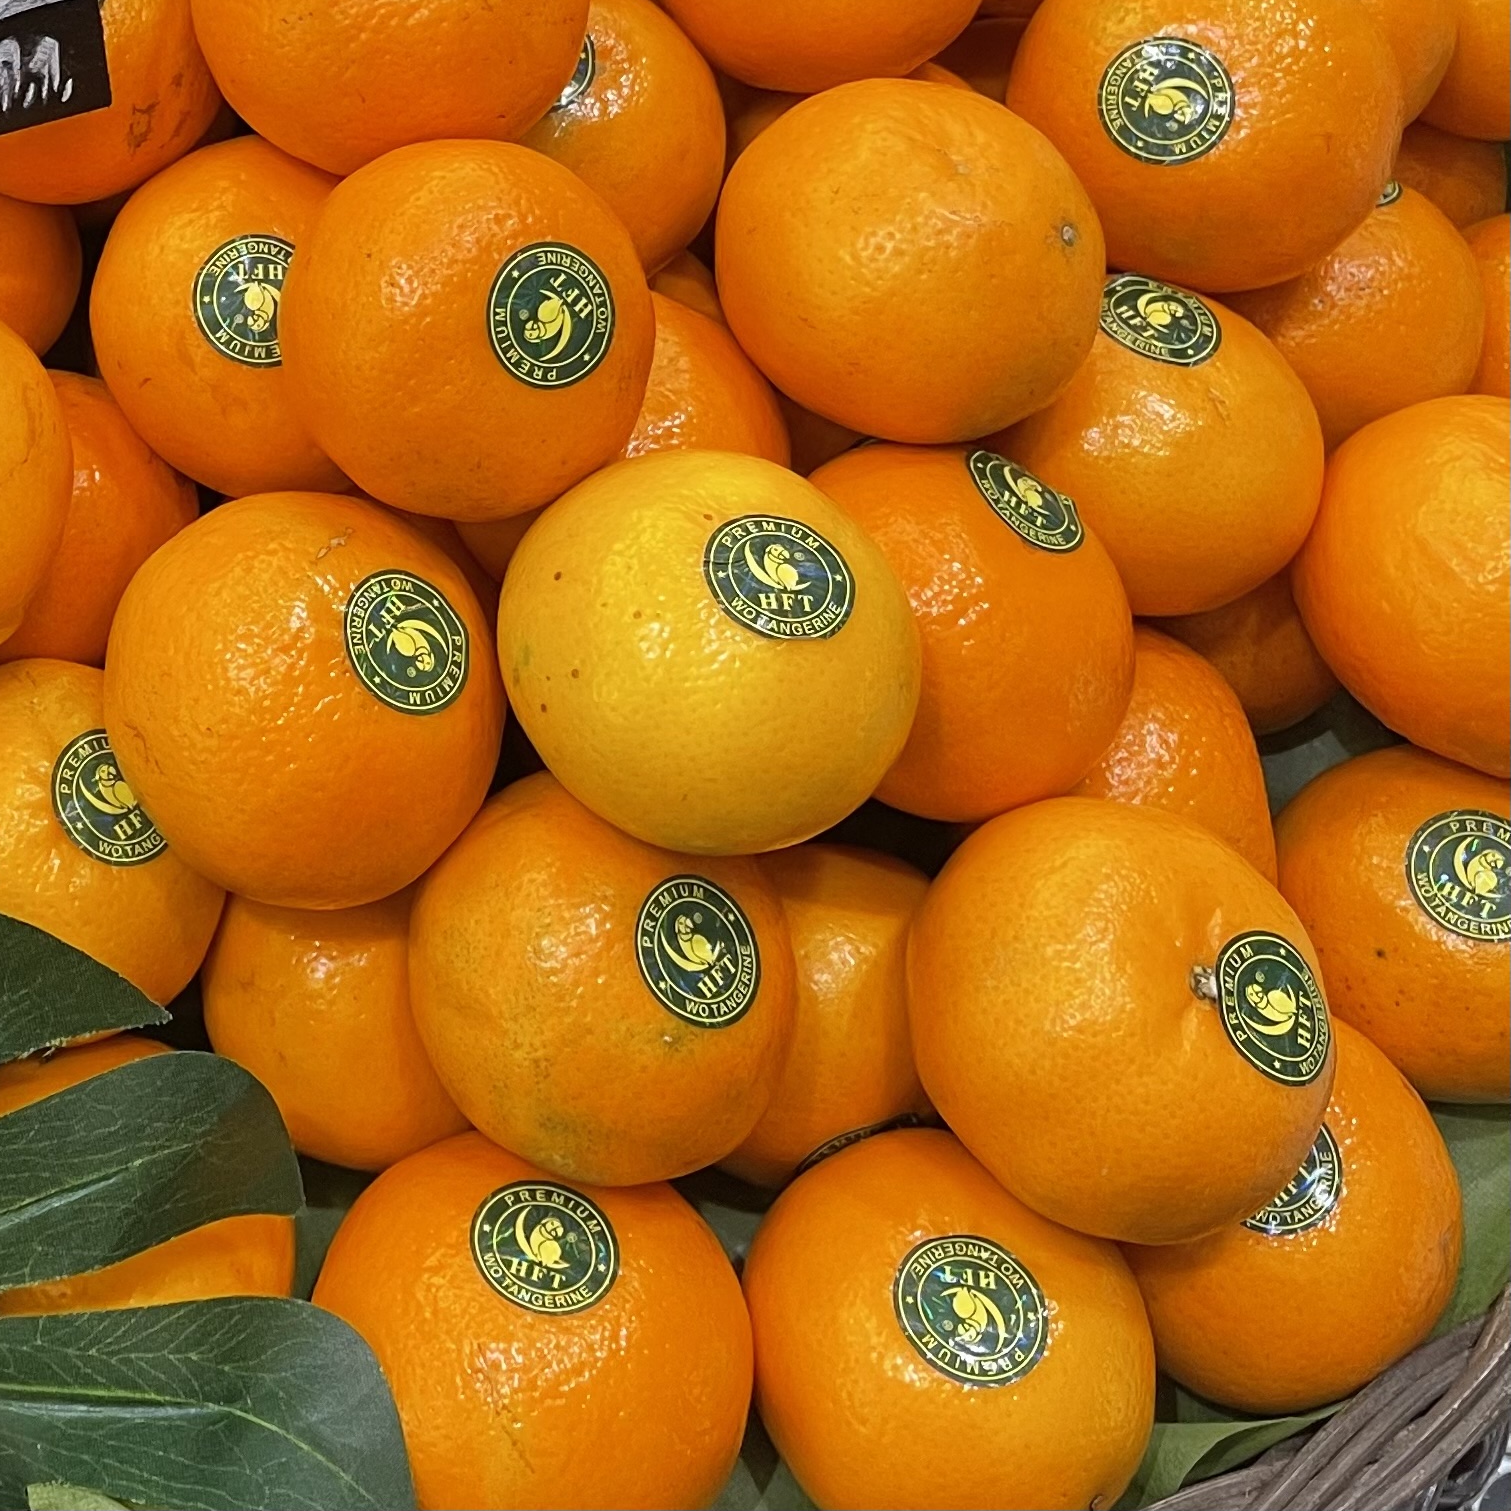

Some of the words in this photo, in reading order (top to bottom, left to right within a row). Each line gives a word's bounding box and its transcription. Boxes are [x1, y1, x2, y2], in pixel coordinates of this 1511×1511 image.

[1124, 64, 1160, 111] HFT
[1174, 74, 1223, 154] PREMIUM
[537, 253, 608, 306] TANGERINE
[549, 272, 591, 319] HFT
[215, 329, 280, 359] EMIUM
[494, 306, 556, 381] PREMIUM
[1114, 304, 1160, 344] HFT
[1001, 490, 1047, 527] HFT
[722, 521, 820, 549] PREMIUM
[389, 578, 415, 592] WO
[758, 592, 814, 612] HFT
[349, 580, 391, 656] TANGERINE
[370, 597, 405, 649] HFT
[730, 596, 758, 621] WO
[756, 600, 845, 636] TANGERINE
[408, 635, 463, 706] PREMIUM
[642, 884, 706, 947] PREMIUM
[1440, 880, 1497, 919] HFT
[696, 955, 738, 999] HFT
[710, 944, 752, 1018] TANGERINE
[1229, 943, 1255, 1042] PREMIUM
[1296, 990, 1313, 1048] HFT
[504, 1189, 603, 1236] PREMIUM
[508, 1256, 567, 1289] HFT
[911, 1242, 1002, 1277] TANGERINE
[940, 1265, 997, 1290] HFT
[999, 1263, 1026, 1289] WO
[921, 1332, 1026, 1375] PREMIUM
